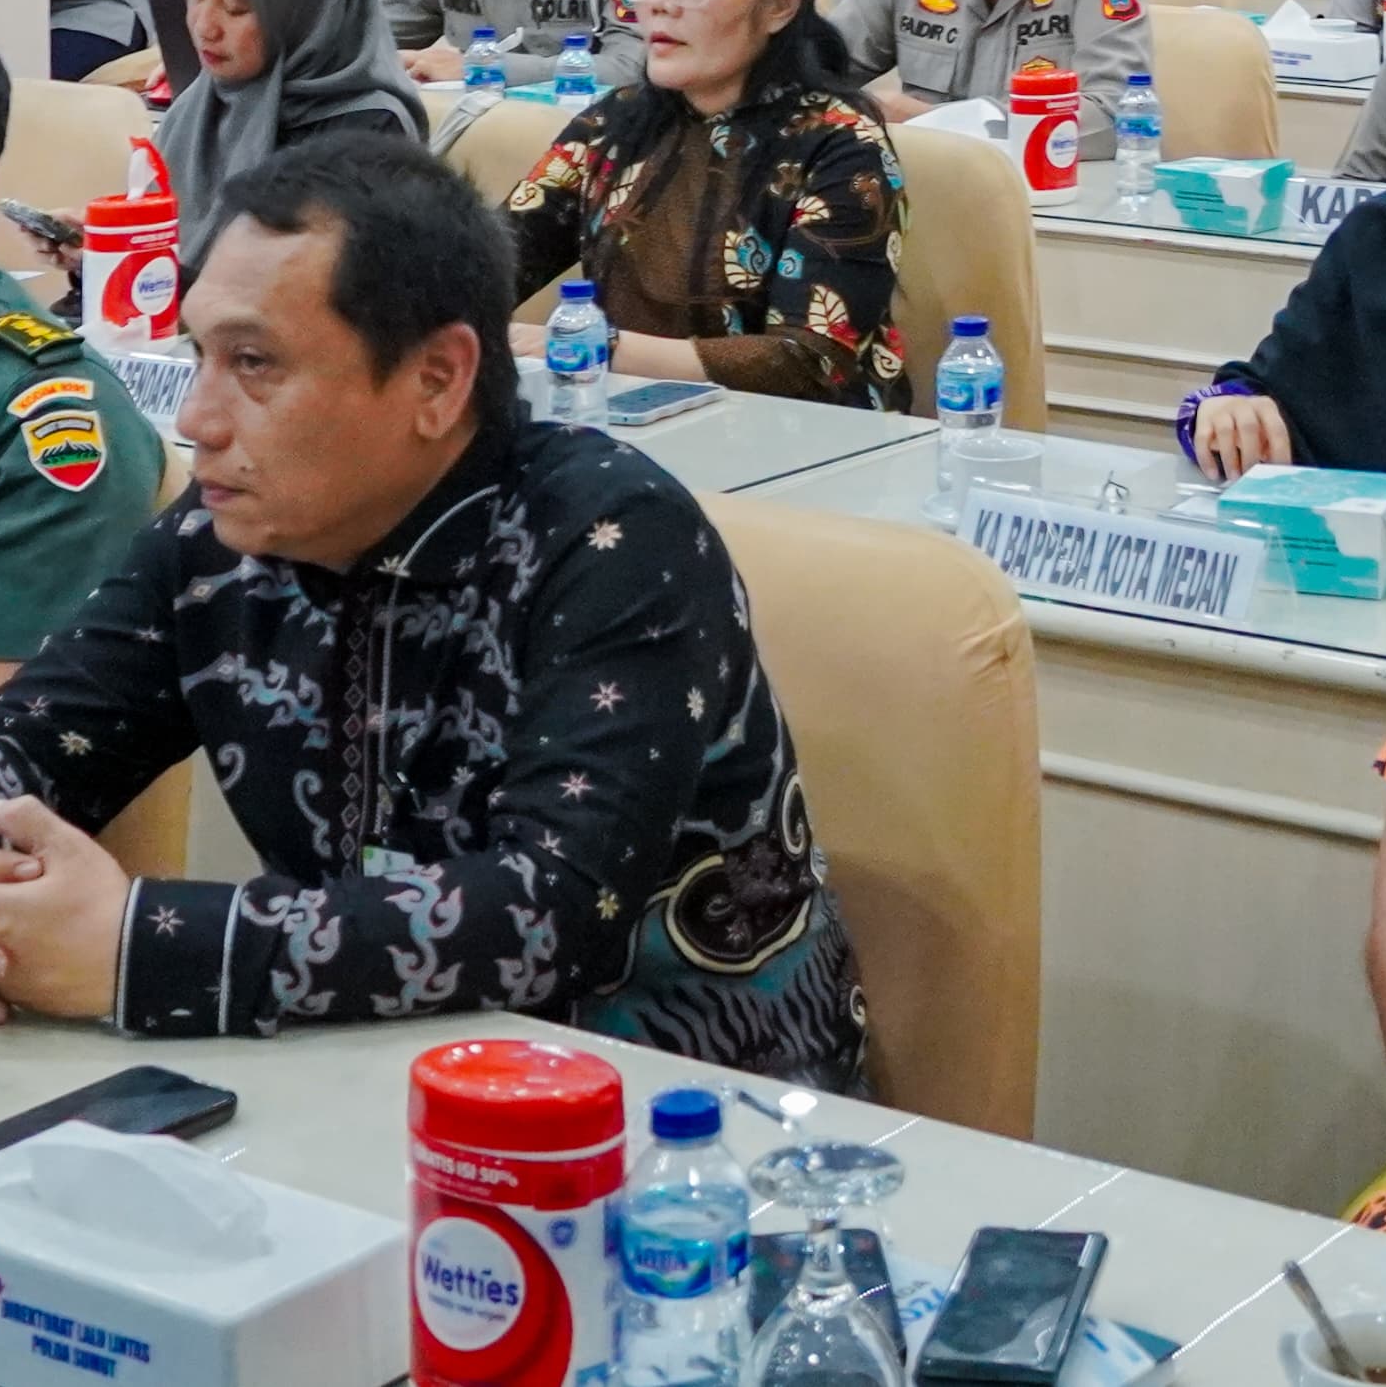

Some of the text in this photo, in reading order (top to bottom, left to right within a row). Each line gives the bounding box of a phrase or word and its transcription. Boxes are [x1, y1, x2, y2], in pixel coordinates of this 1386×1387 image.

[946, 27, 958, 44] C
[1017, 14, 1070, 42] POLRI
[999, 516, 1094, 585] BAPPEDA
[1092, 532, 1157, 601] KOTA
[1153, 544, 1239, 615] MEDAN
[421, 1254, 520, 1307] Wetties
